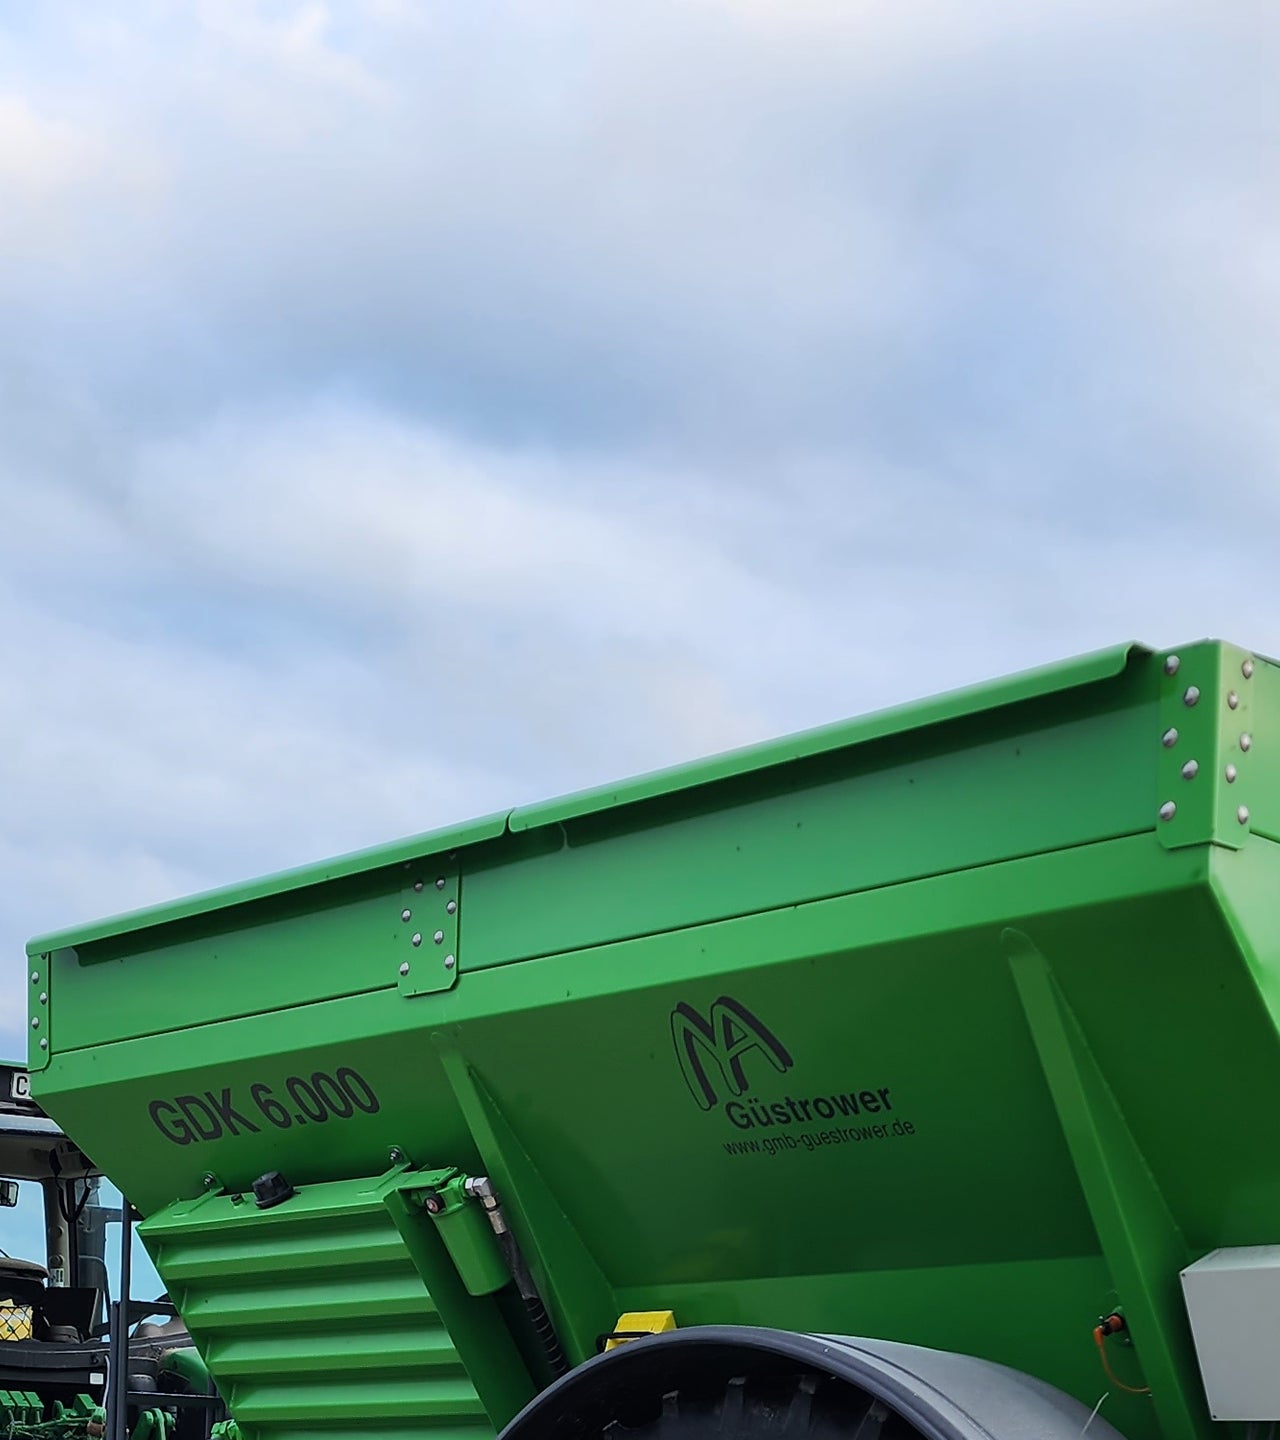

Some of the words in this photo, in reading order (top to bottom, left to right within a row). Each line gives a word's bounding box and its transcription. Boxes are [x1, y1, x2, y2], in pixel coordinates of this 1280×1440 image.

[148, 1088, 261, 1145] GDK
[250, 1067, 380, 1129] 6.000
[725, 1087, 893, 1130] Güstrower
[723, 1118, 916, 1155] www.gmb-guestrower.de
